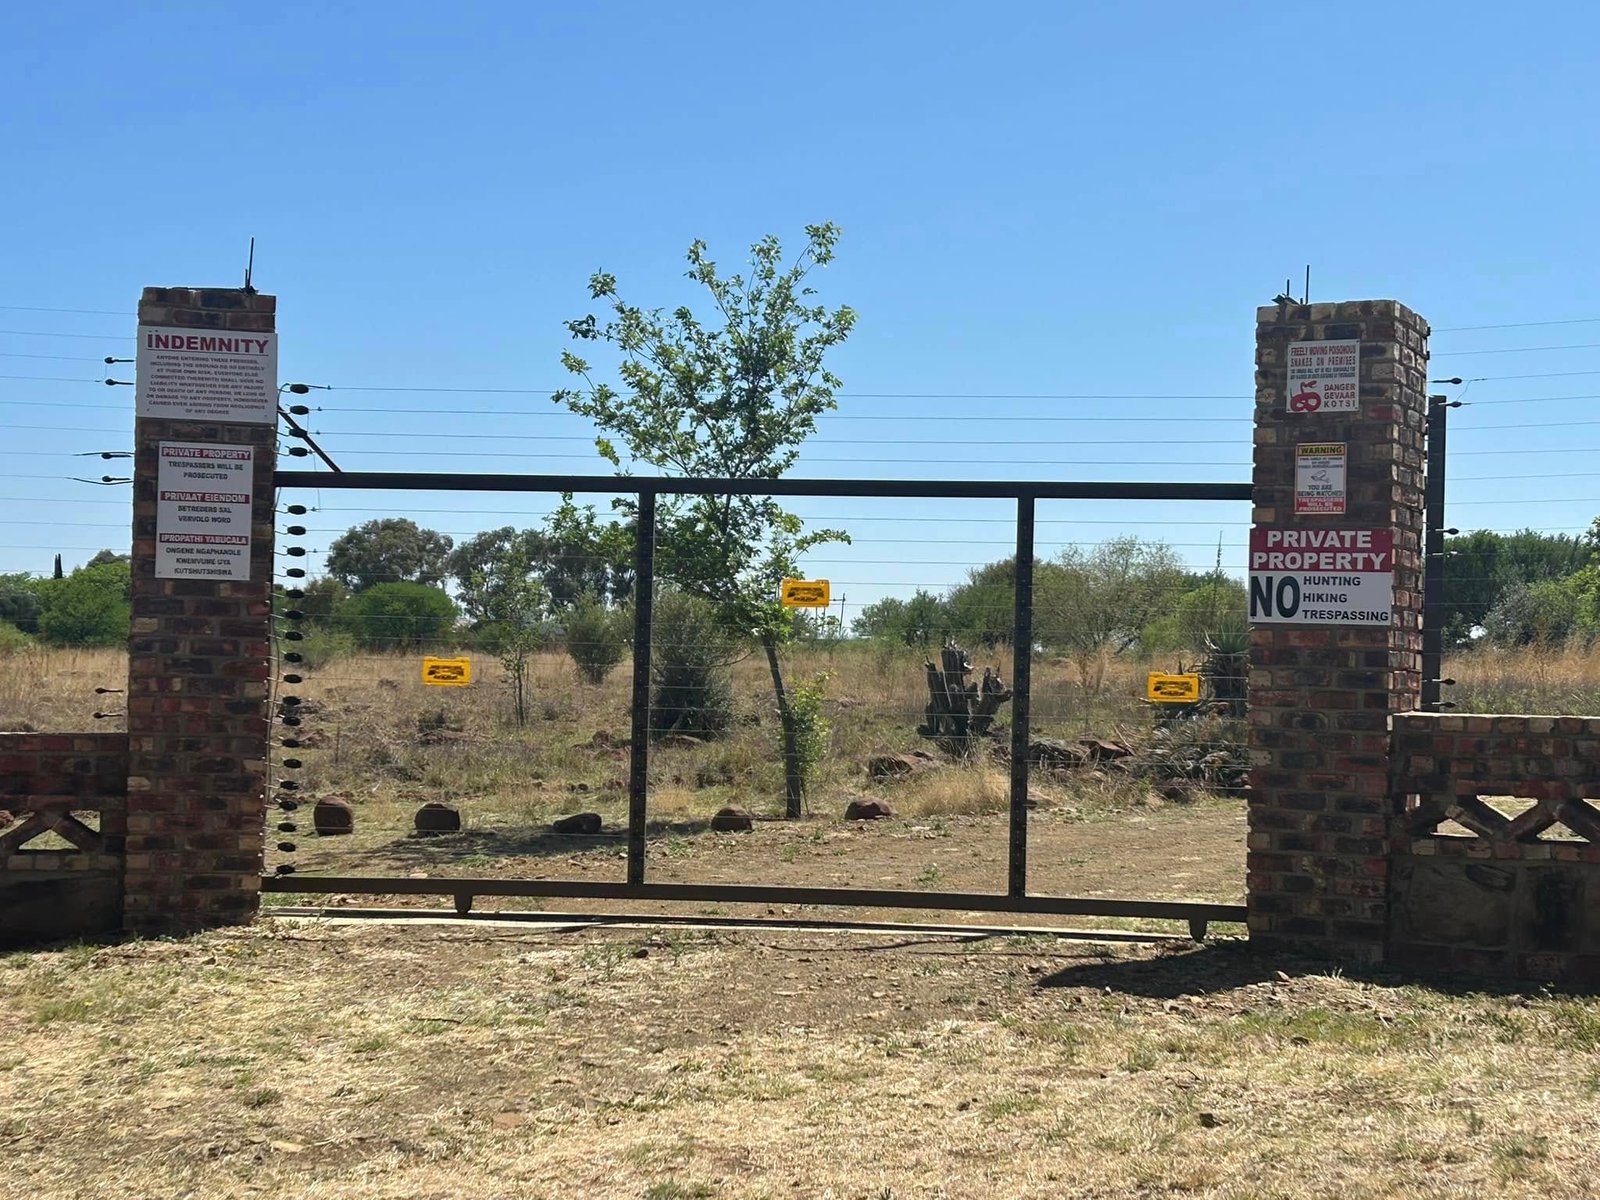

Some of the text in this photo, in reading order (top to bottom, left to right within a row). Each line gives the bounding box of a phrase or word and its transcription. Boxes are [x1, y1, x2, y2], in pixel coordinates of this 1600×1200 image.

[147, 334, 268, 353] INDEMNITY
[1291, 358, 1312, 366] SNAKES
[163, 448, 250, 459] PRIVATE PROPERTY
[169, 461, 215, 469] TRESPASSERS
[165, 492, 246, 503] PRIVAAT EIENDOM
[205, 536, 246, 544] YABUCALA
[1267, 531, 1372, 548] PRIVATE
[1253, 552, 1386, 570] PROPERTY
[1304, 576, 1361, 586] HUNTING
[1250, 576, 1300, 618] NO
[1303, 593, 1347, 603] HIKING
[1302, 610, 1388, 621] TRESPASSING
